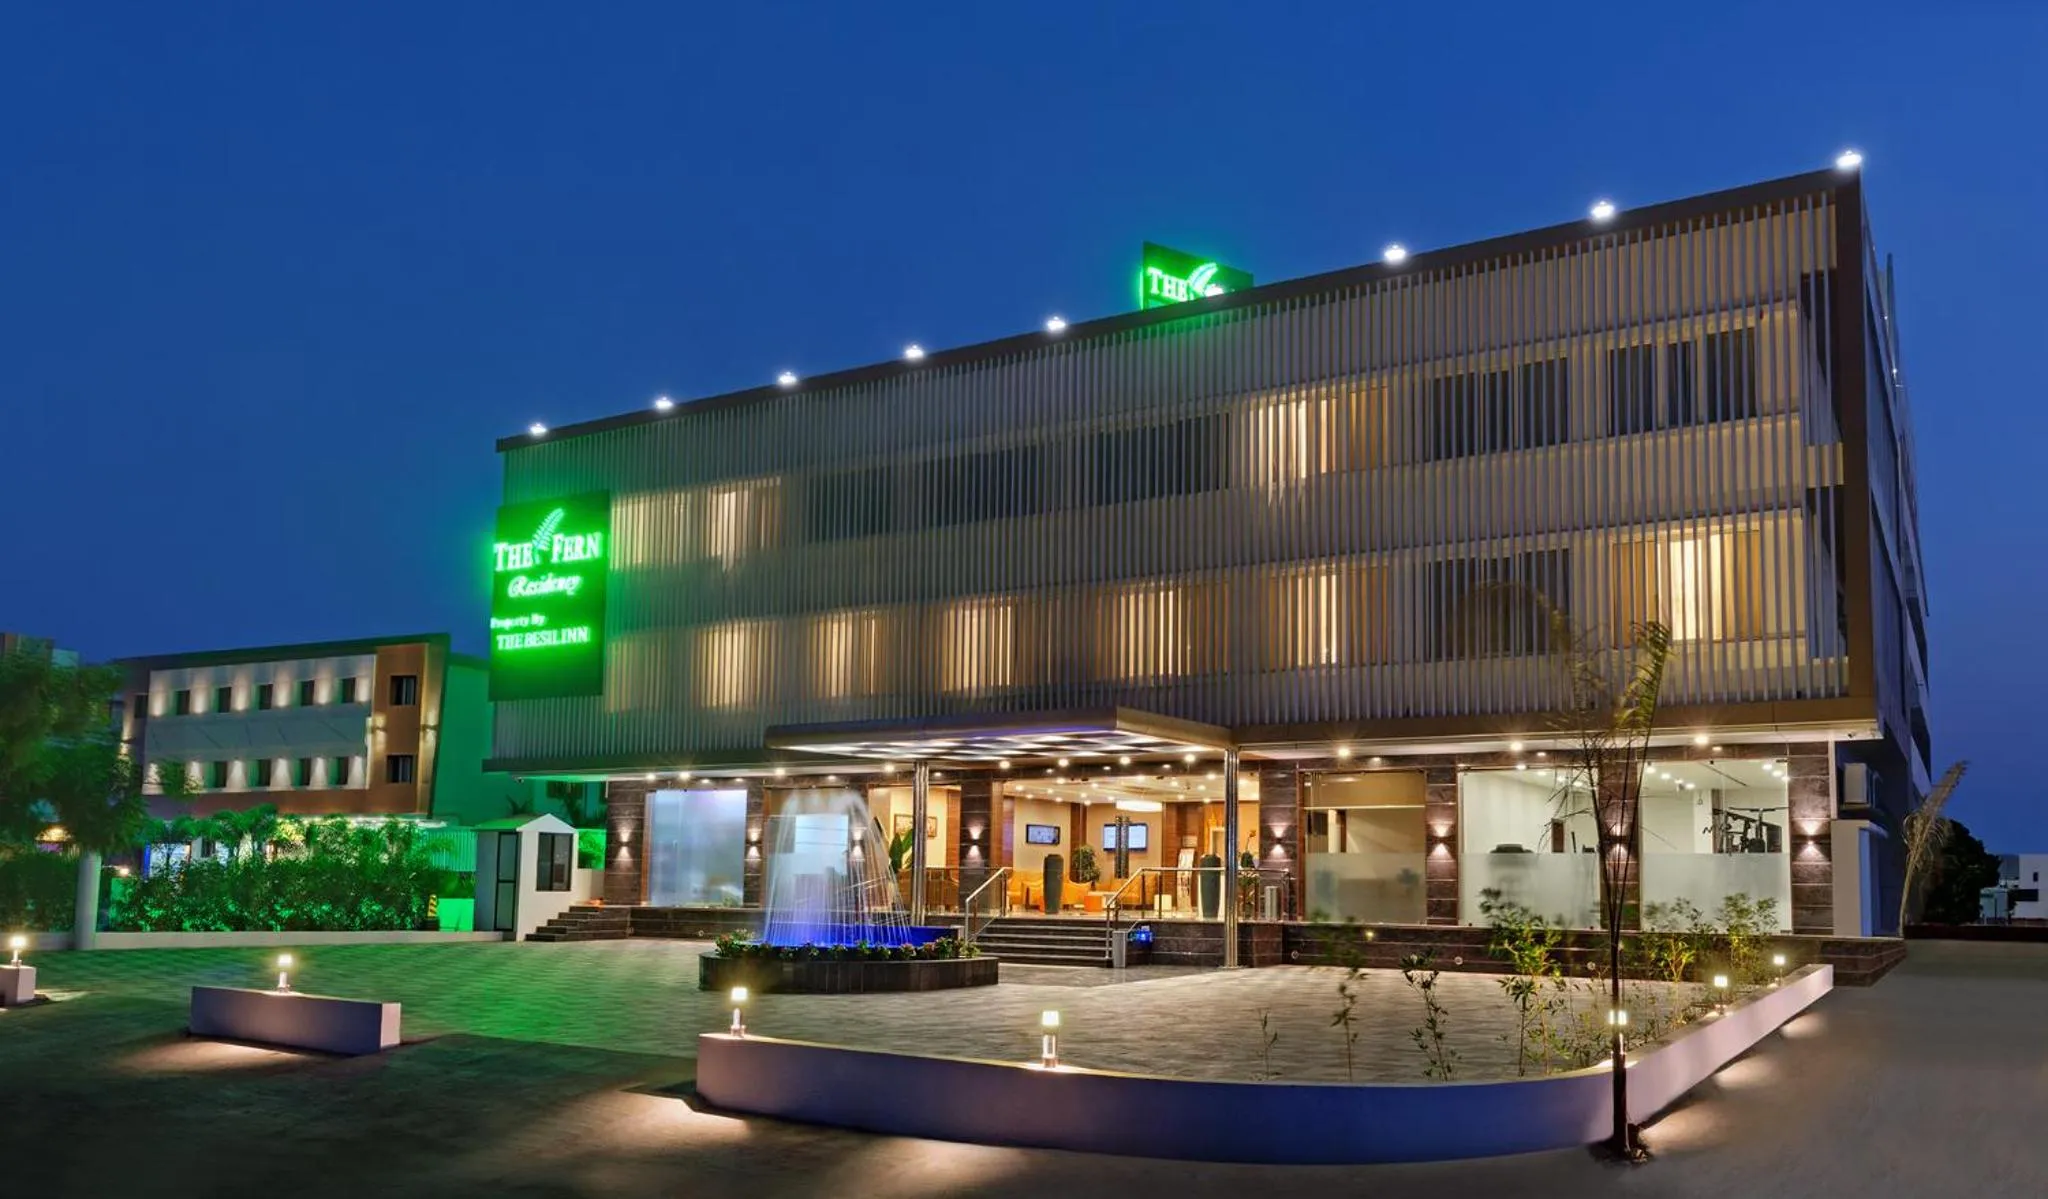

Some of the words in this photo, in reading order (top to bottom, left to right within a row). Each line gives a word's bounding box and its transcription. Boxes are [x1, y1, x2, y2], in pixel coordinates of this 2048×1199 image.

[1146, 266, 1187, 302] THE
[493, 541, 534, 572] THE
[551, 531, 602, 563] FERN
